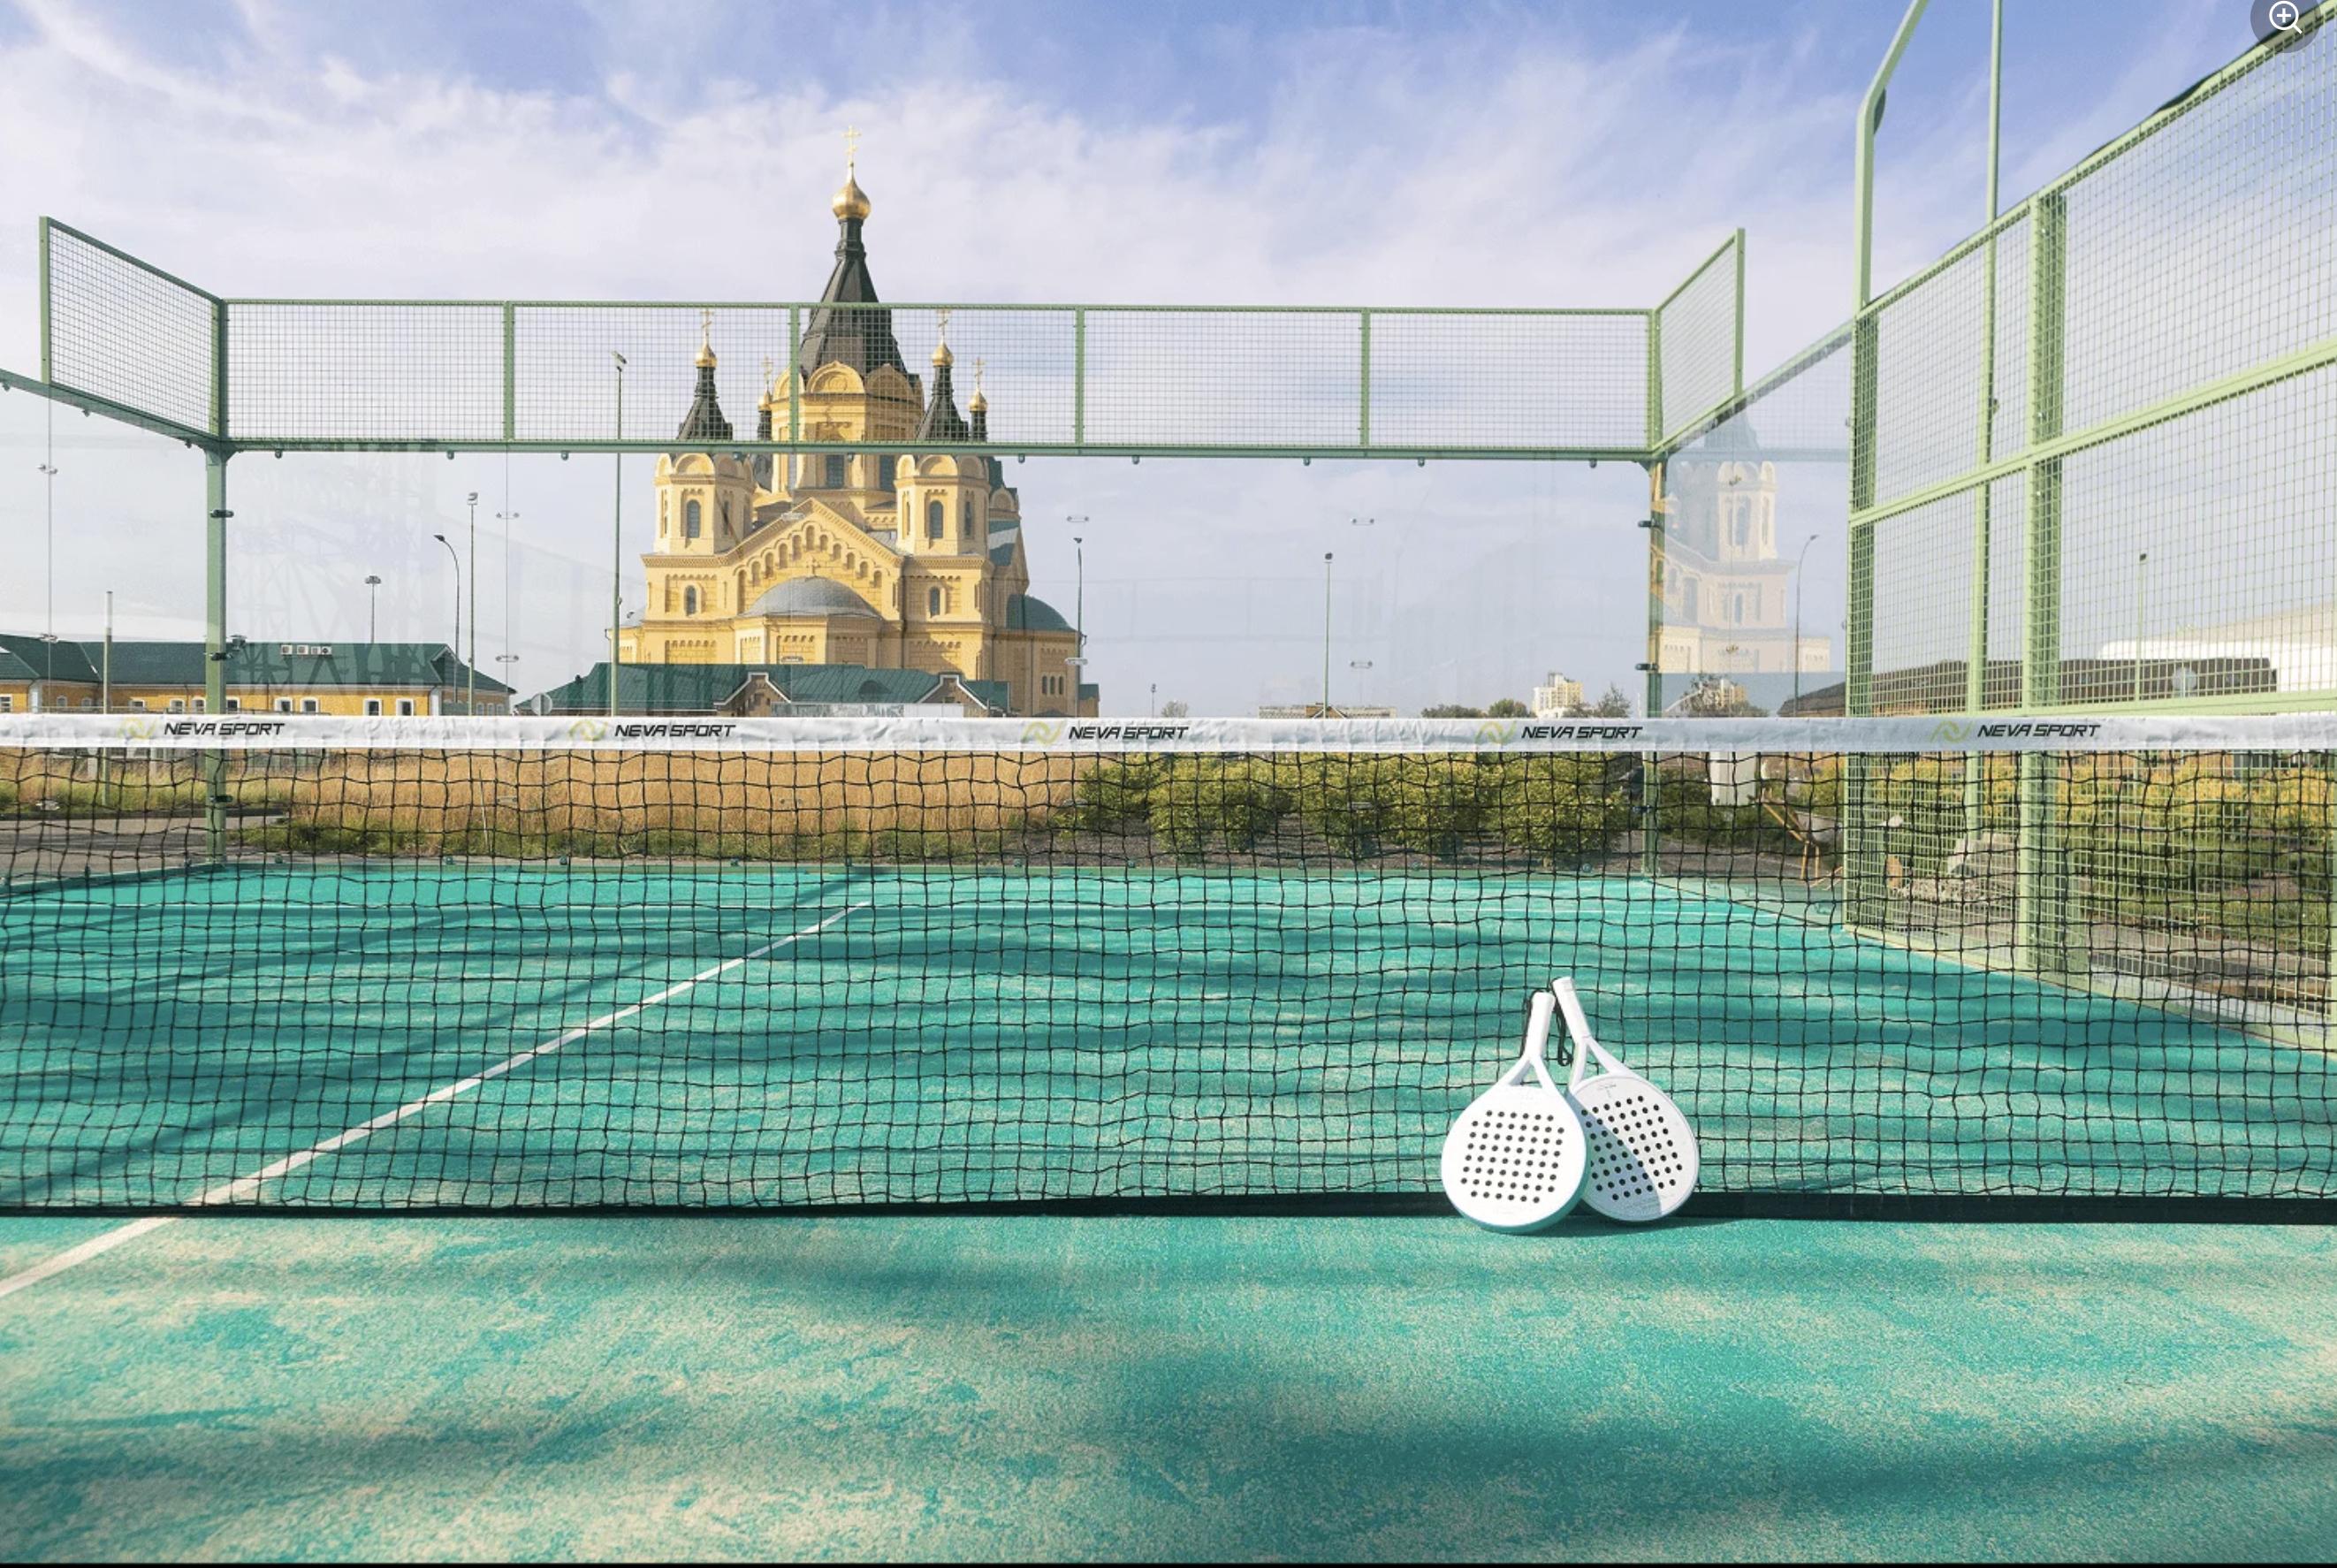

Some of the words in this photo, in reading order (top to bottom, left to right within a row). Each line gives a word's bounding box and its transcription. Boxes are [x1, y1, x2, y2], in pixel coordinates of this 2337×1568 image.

[164, 722, 216, 735] NEVA
[218, 722, 285, 735] SPORT
[614, 725, 667, 737] NEVA
[669, 725, 736, 737] SPORT
[1069, 727, 1122, 739] NEVA
[1122, 727, 1189, 739] SPORT
[1521, 727, 1574, 739] NEVA
[1576, 727, 1643, 739] SPORT
[1977, 724, 2032, 737] NEVA
[2033, 724, 2100, 737] SPORT
